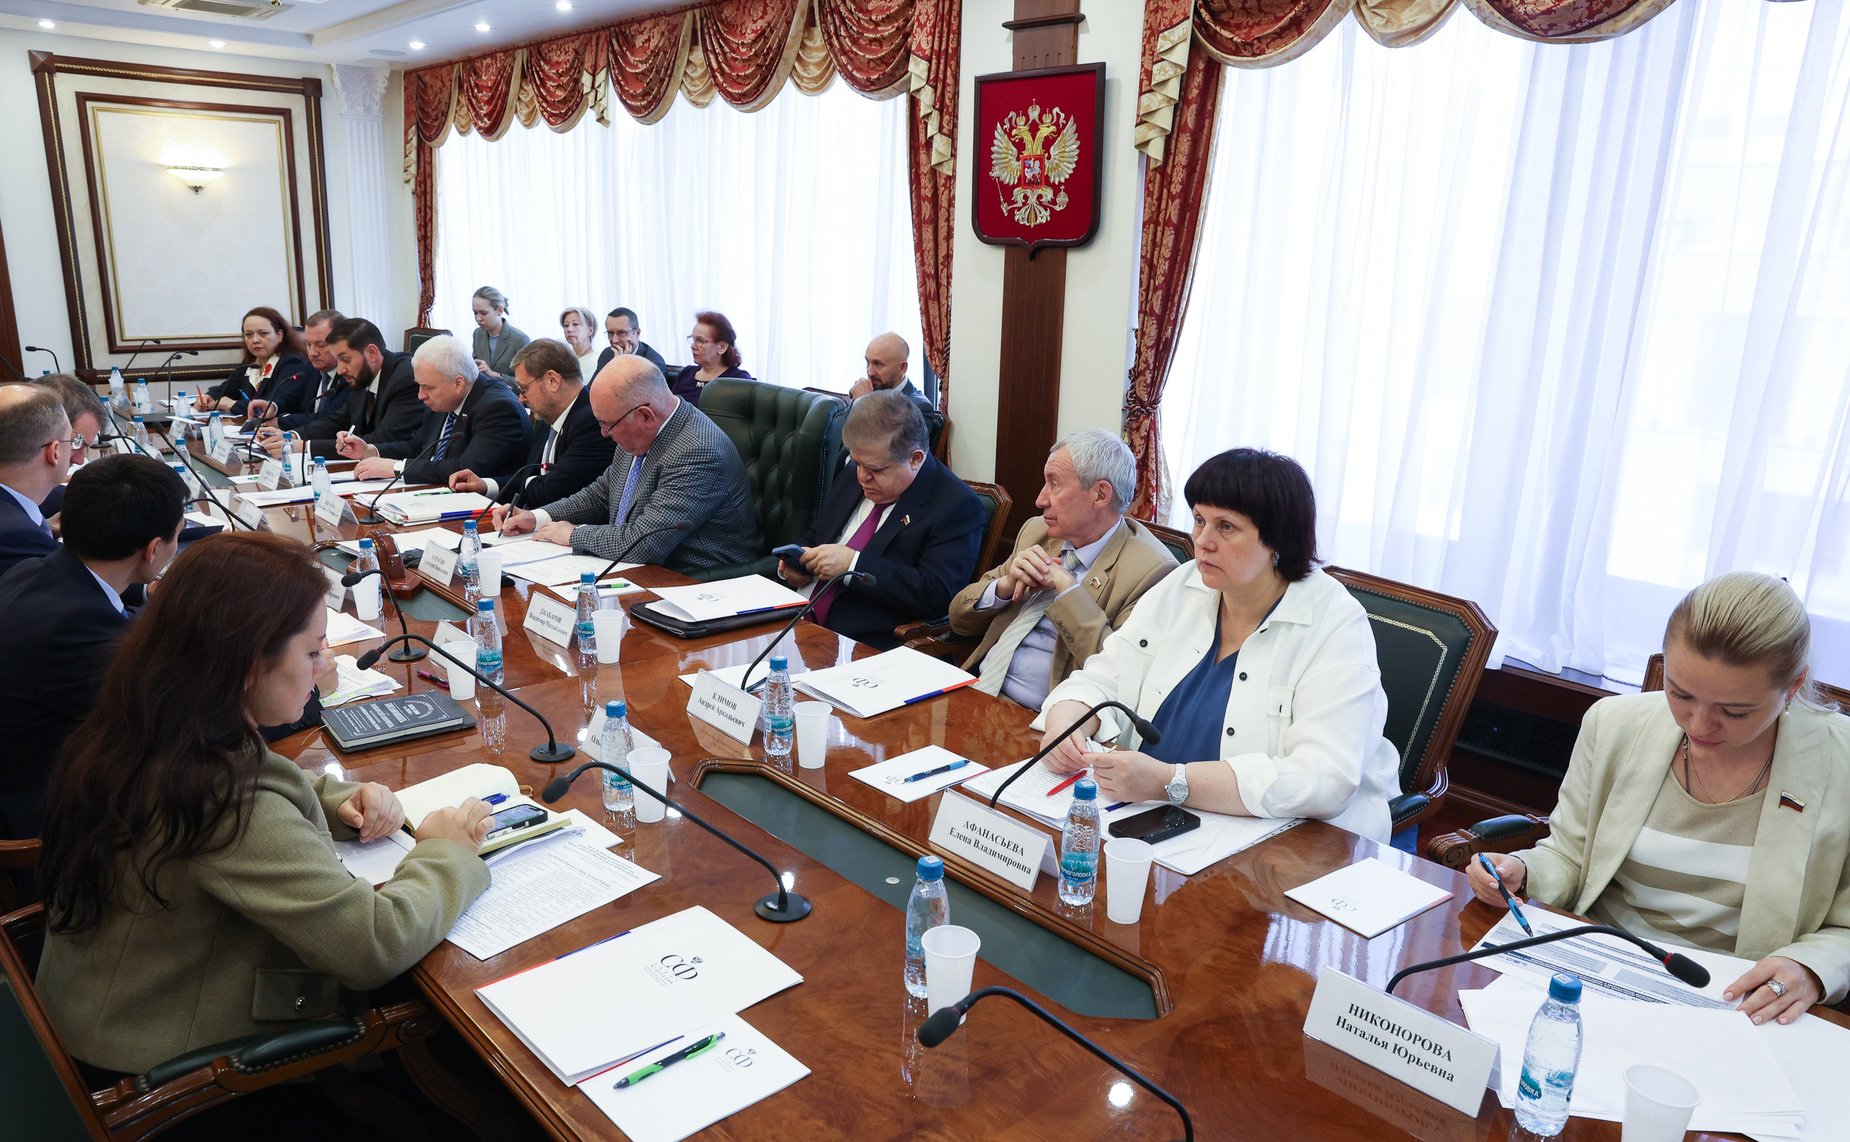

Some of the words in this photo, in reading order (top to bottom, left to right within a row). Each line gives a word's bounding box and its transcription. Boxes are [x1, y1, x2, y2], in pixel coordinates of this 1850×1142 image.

[698, 697, 716, 714] Андрей
[711, 692, 738, 711] КЛИМОВ
[949, 827, 972, 845] Елена
[973, 839, 1032, 875] Владимировна
[962, 820, 1025, 856] АФАНАСЬЕВА
[1335, 1015, 1389, 1050] Наталья
[1392, 1043, 1455, 1082] Юрьевна
[1348, 1003, 1453, 1062] НИКОНОРОВА
